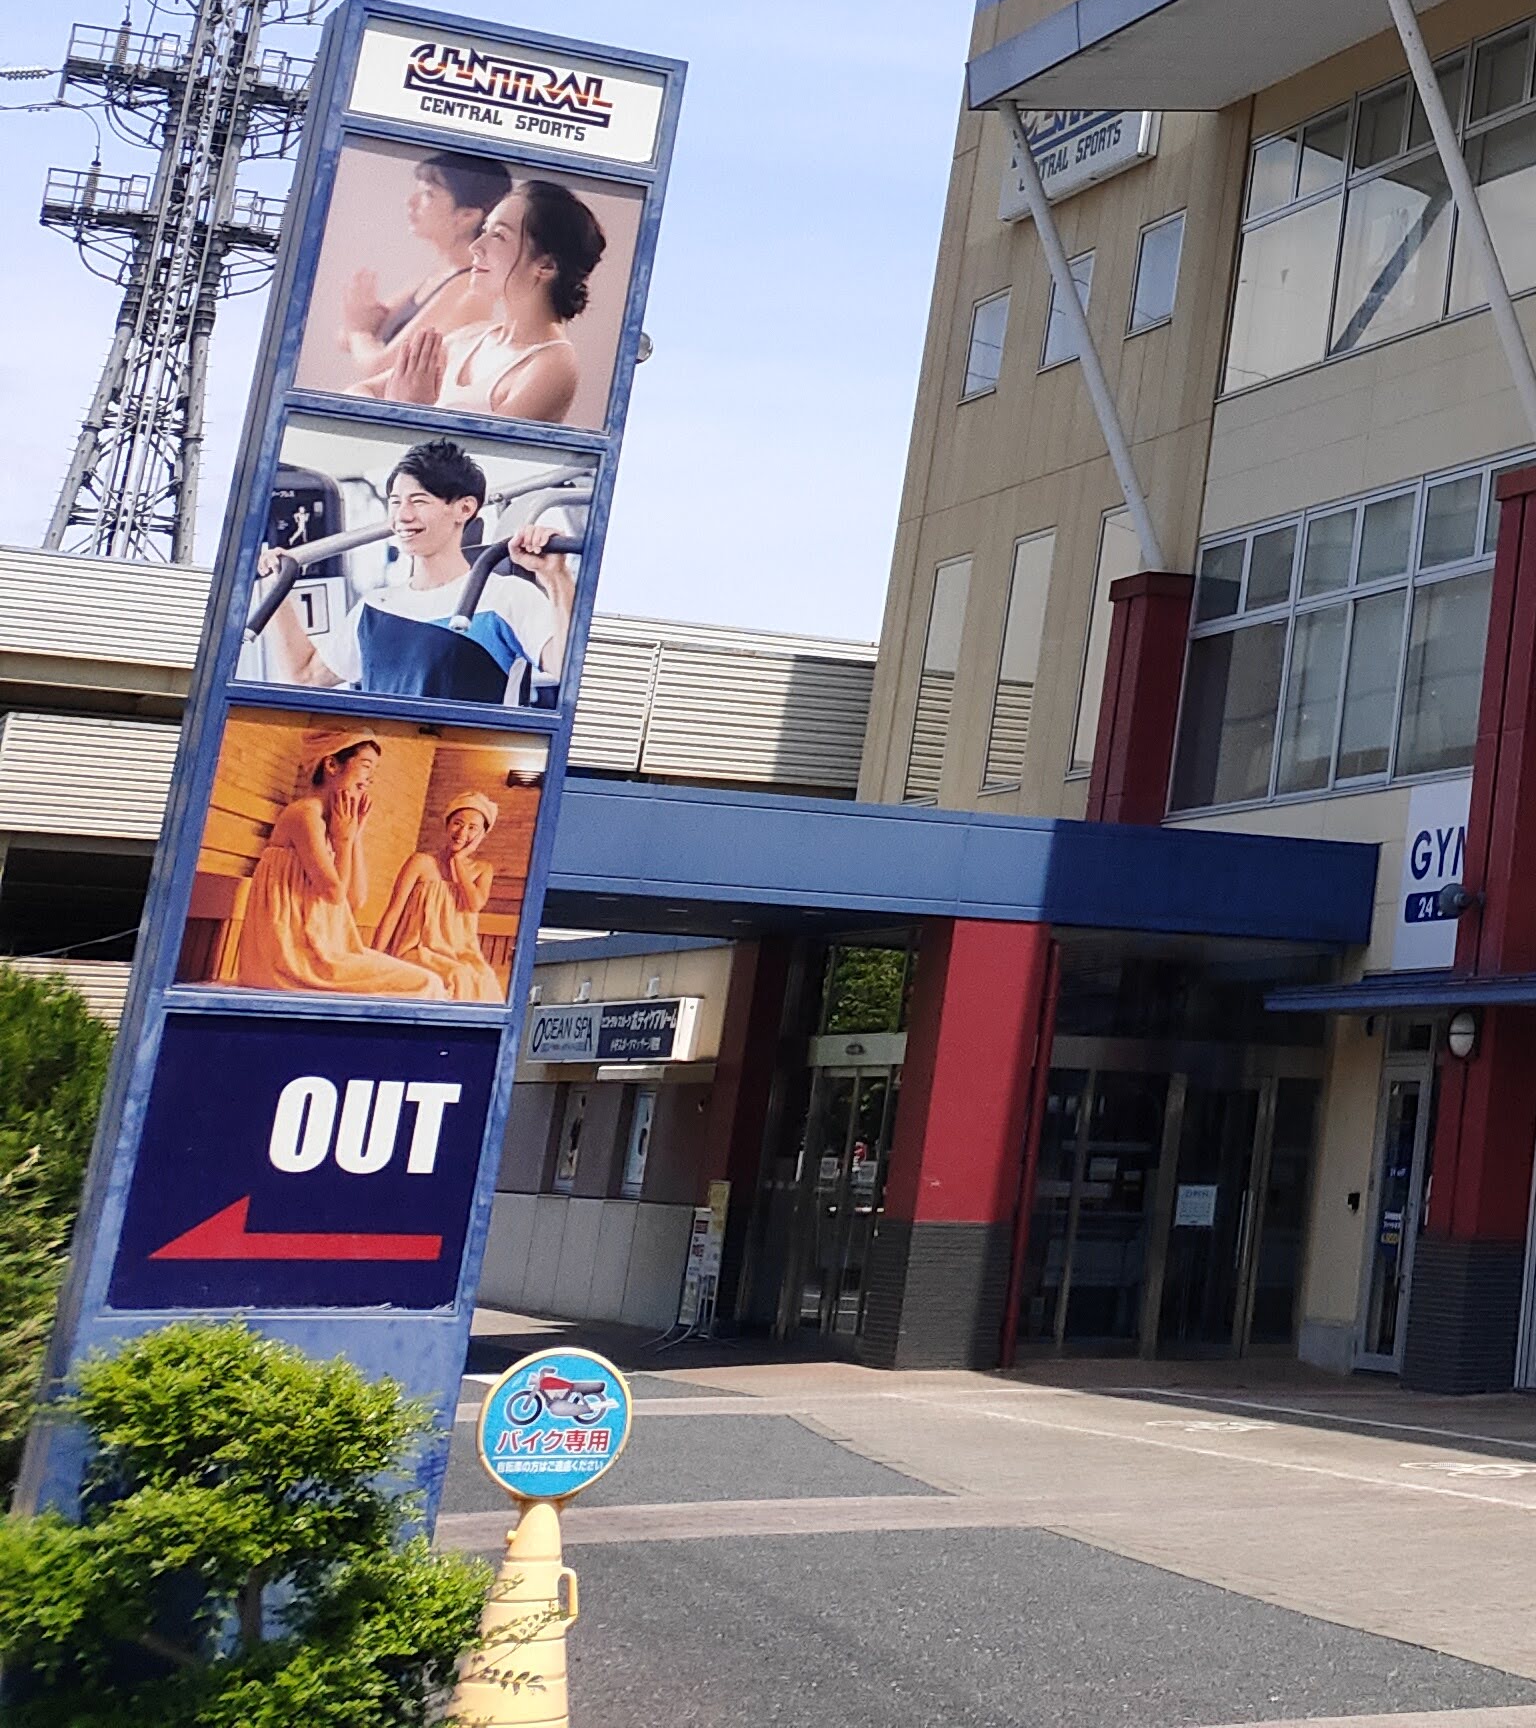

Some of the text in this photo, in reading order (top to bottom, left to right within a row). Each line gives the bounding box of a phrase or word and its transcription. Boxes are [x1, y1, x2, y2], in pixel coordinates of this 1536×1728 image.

[403, 43, 614, 128] CENTRAL
[420, 95, 587, 142] CENTRAL SPORTS
[1075, 119, 1123, 164] SPORTS
[301, 593, 314, 628] 1
[533, 1017, 572, 1053] OCEAN
[574, 1016, 593, 1052] SPA
[269, 1076, 462, 1174] OUT
[496, 1428, 611, 1453] バイク専用
